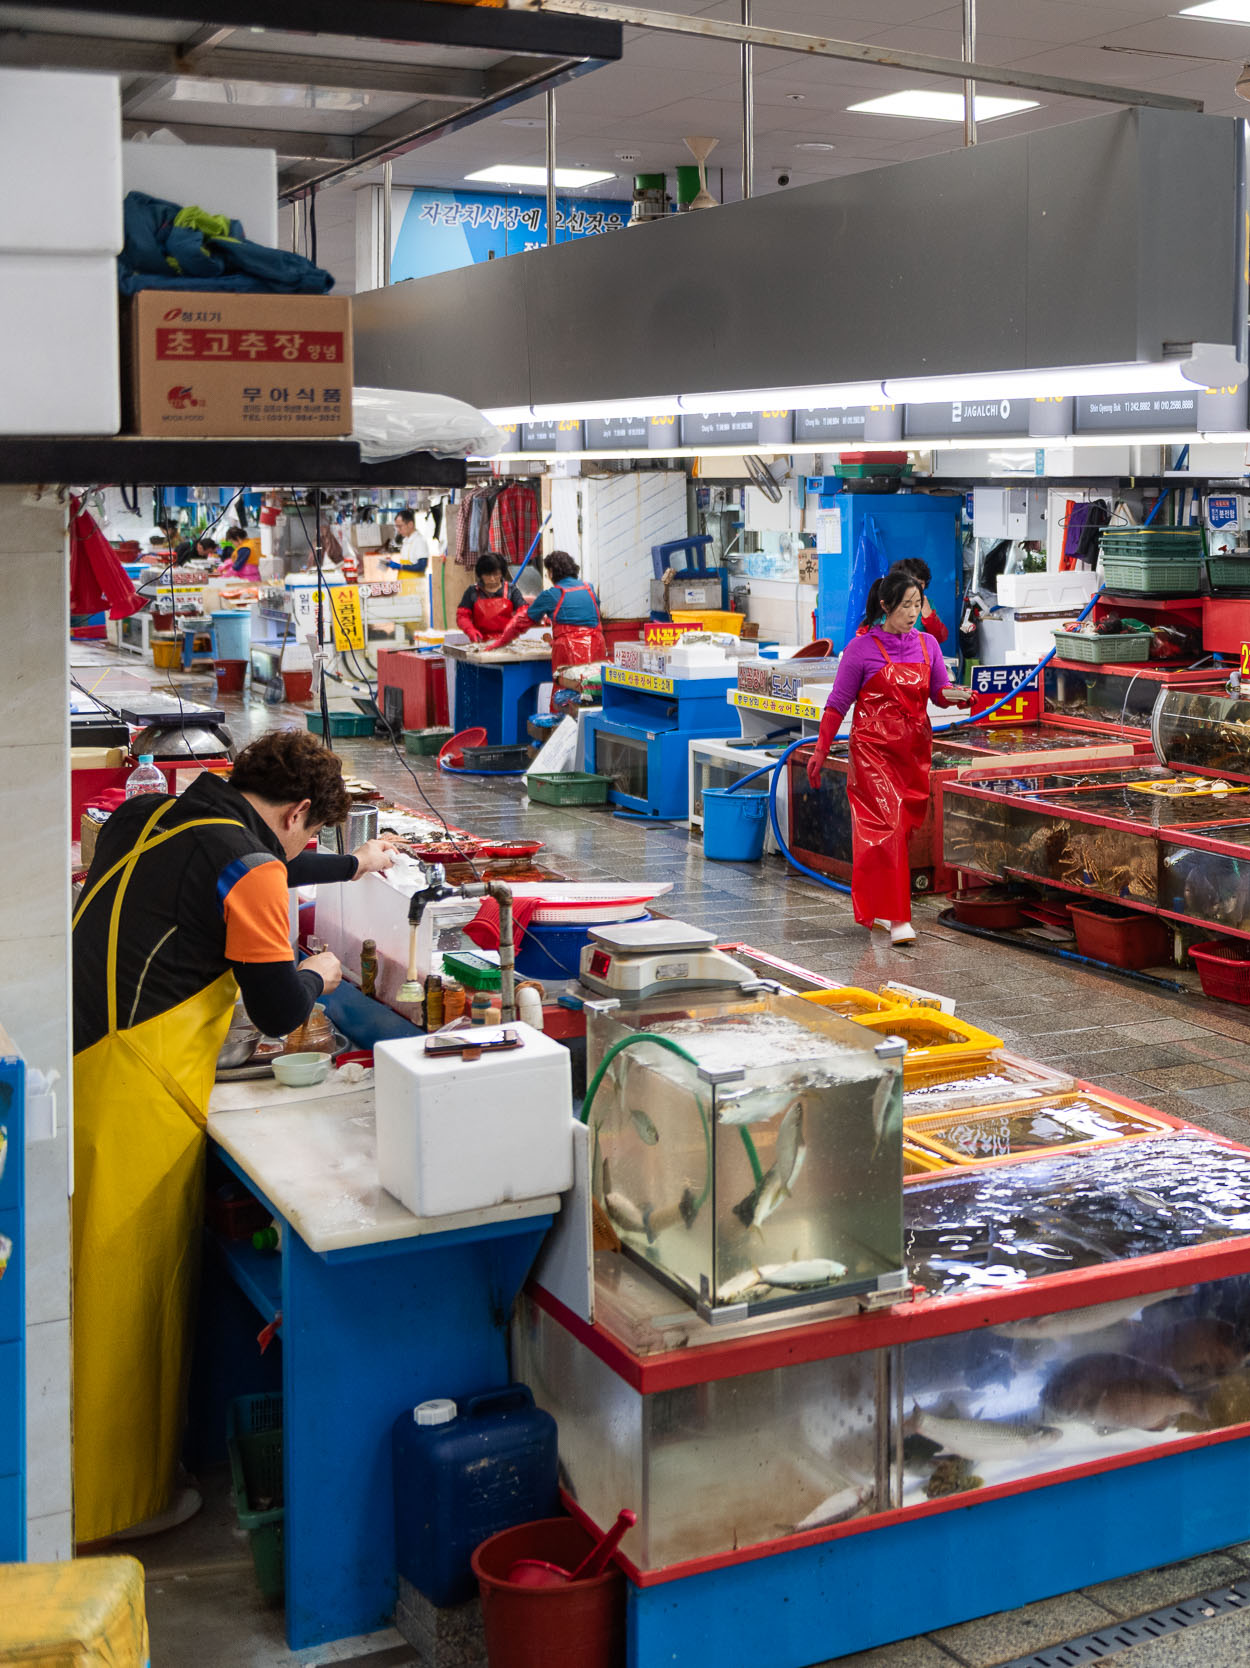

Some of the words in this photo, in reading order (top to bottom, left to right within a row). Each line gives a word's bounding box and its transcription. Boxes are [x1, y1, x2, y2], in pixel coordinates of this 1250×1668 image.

[419, 202, 541, 233] 자갈치시장에
[165, 331, 304, 360] 초고추장
[307, 344, 337, 361] 양념
[963, 404, 998, 419] JAGALCHI
[647, 627, 702, 650] 산꼼
[986, 696, 1029, 721] 산
